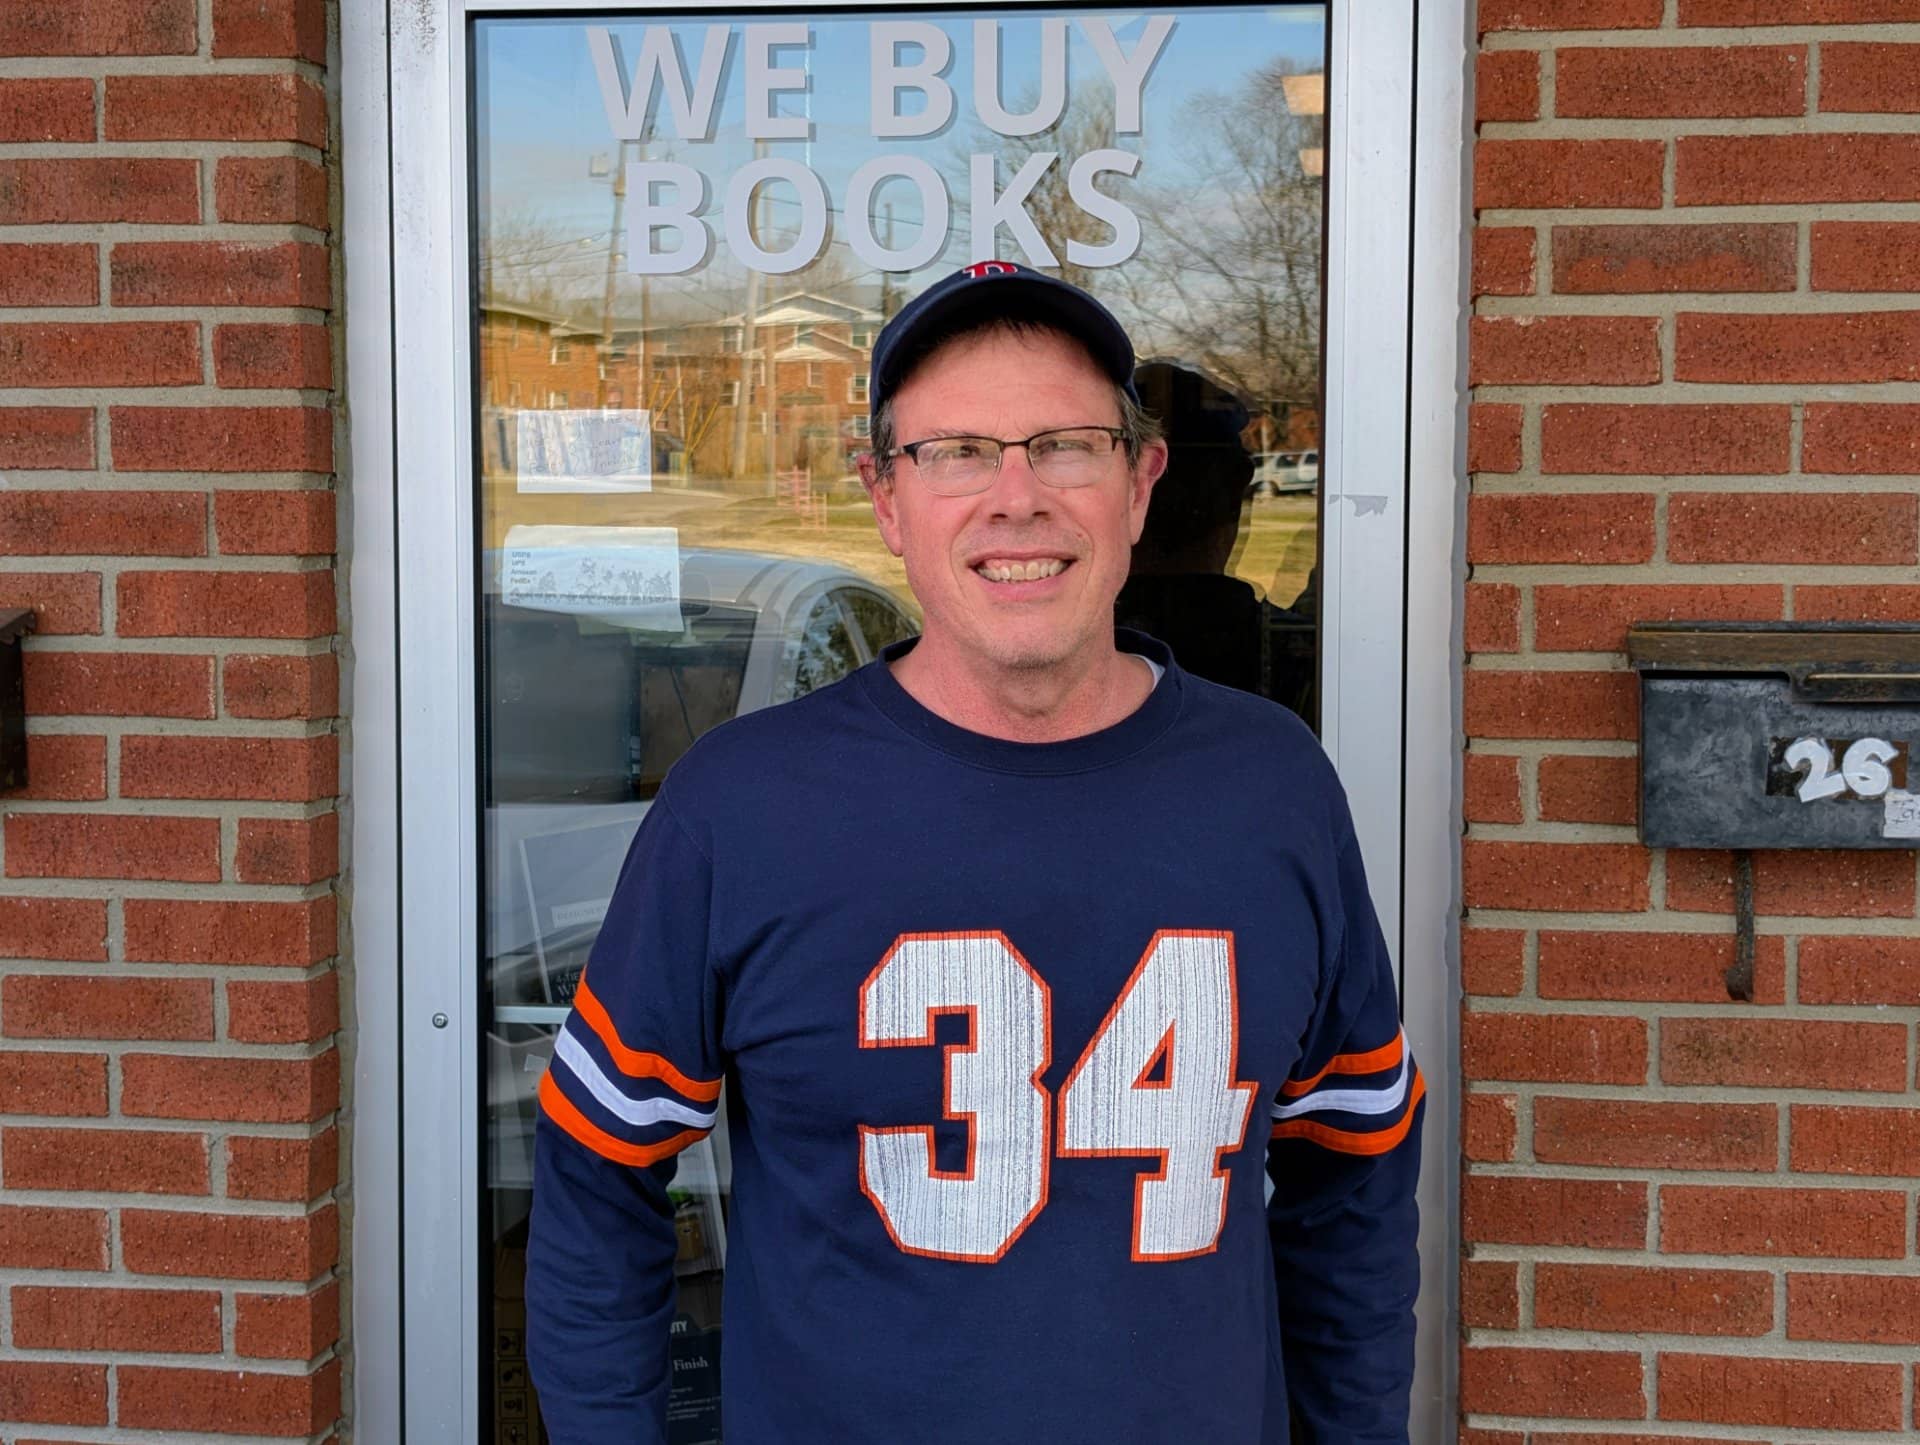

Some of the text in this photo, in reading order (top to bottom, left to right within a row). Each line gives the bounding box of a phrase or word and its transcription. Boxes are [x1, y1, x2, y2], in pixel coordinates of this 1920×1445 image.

[587, 15, 1178, 142] WE BUY
[625, 149, 1144, 275] BOOKS
[1784, 737, 1899, 803] 26
[857, 928, 1260, 1264] 34
[673, 1356, 709, 1372] Finish
